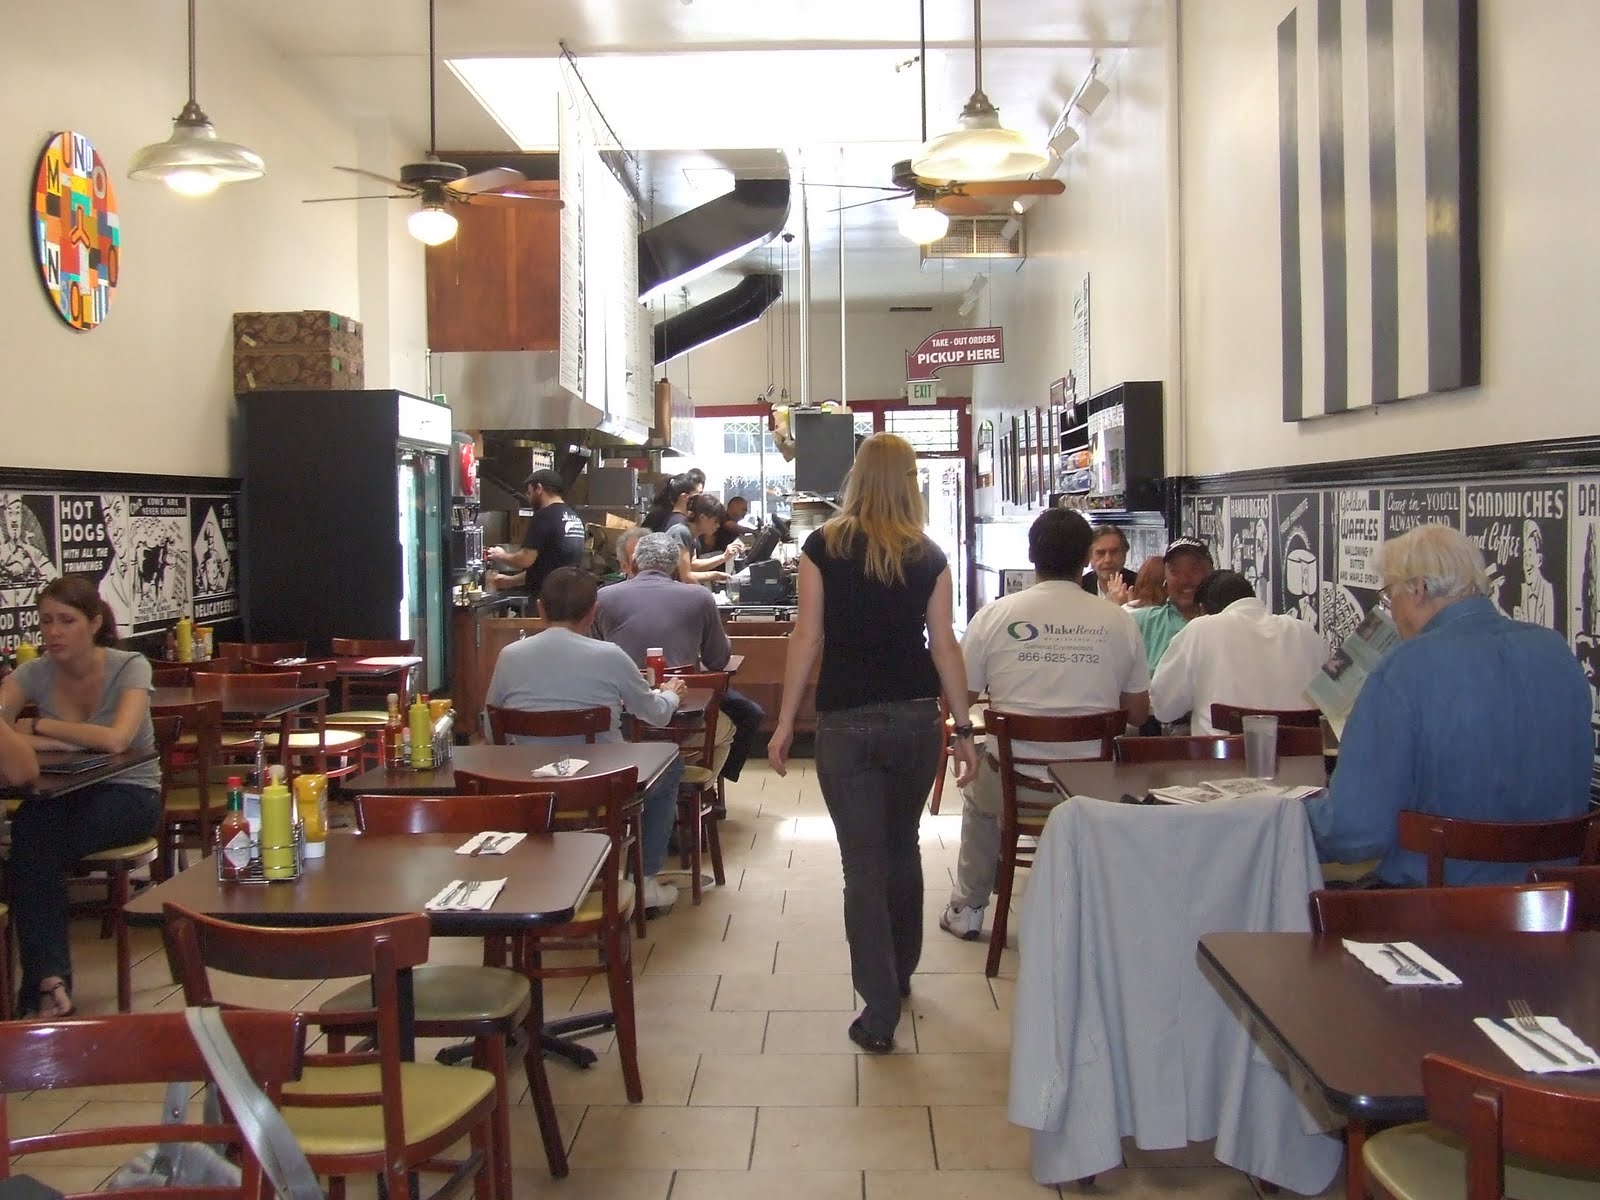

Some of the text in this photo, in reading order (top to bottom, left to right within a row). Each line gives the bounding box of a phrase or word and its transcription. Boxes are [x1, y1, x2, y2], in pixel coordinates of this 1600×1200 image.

[932, 338, 949, 348] TAKE
[953, 336, 968, 346] OUT
[968, 334, 996, 345] ORDERS
[917, 348, 1000, 364] PICKUP HERE
[914, 384, 932, 398] EXIT
[61, 501, 94, 521] HOT
[1468, 489, 1564, 519] SANDWICHES
[62, 523, 105, 542] DOGS
[1341, 518, 1379, 541] WAFFLES
[1488, 521, 1520, 566] Coffee
[63, 547, 108, 559] WITH ALL THE
[65, 560, 104, 573] TRIMMINGS
[1018, 652, 1100, 664] 866-625-3732
